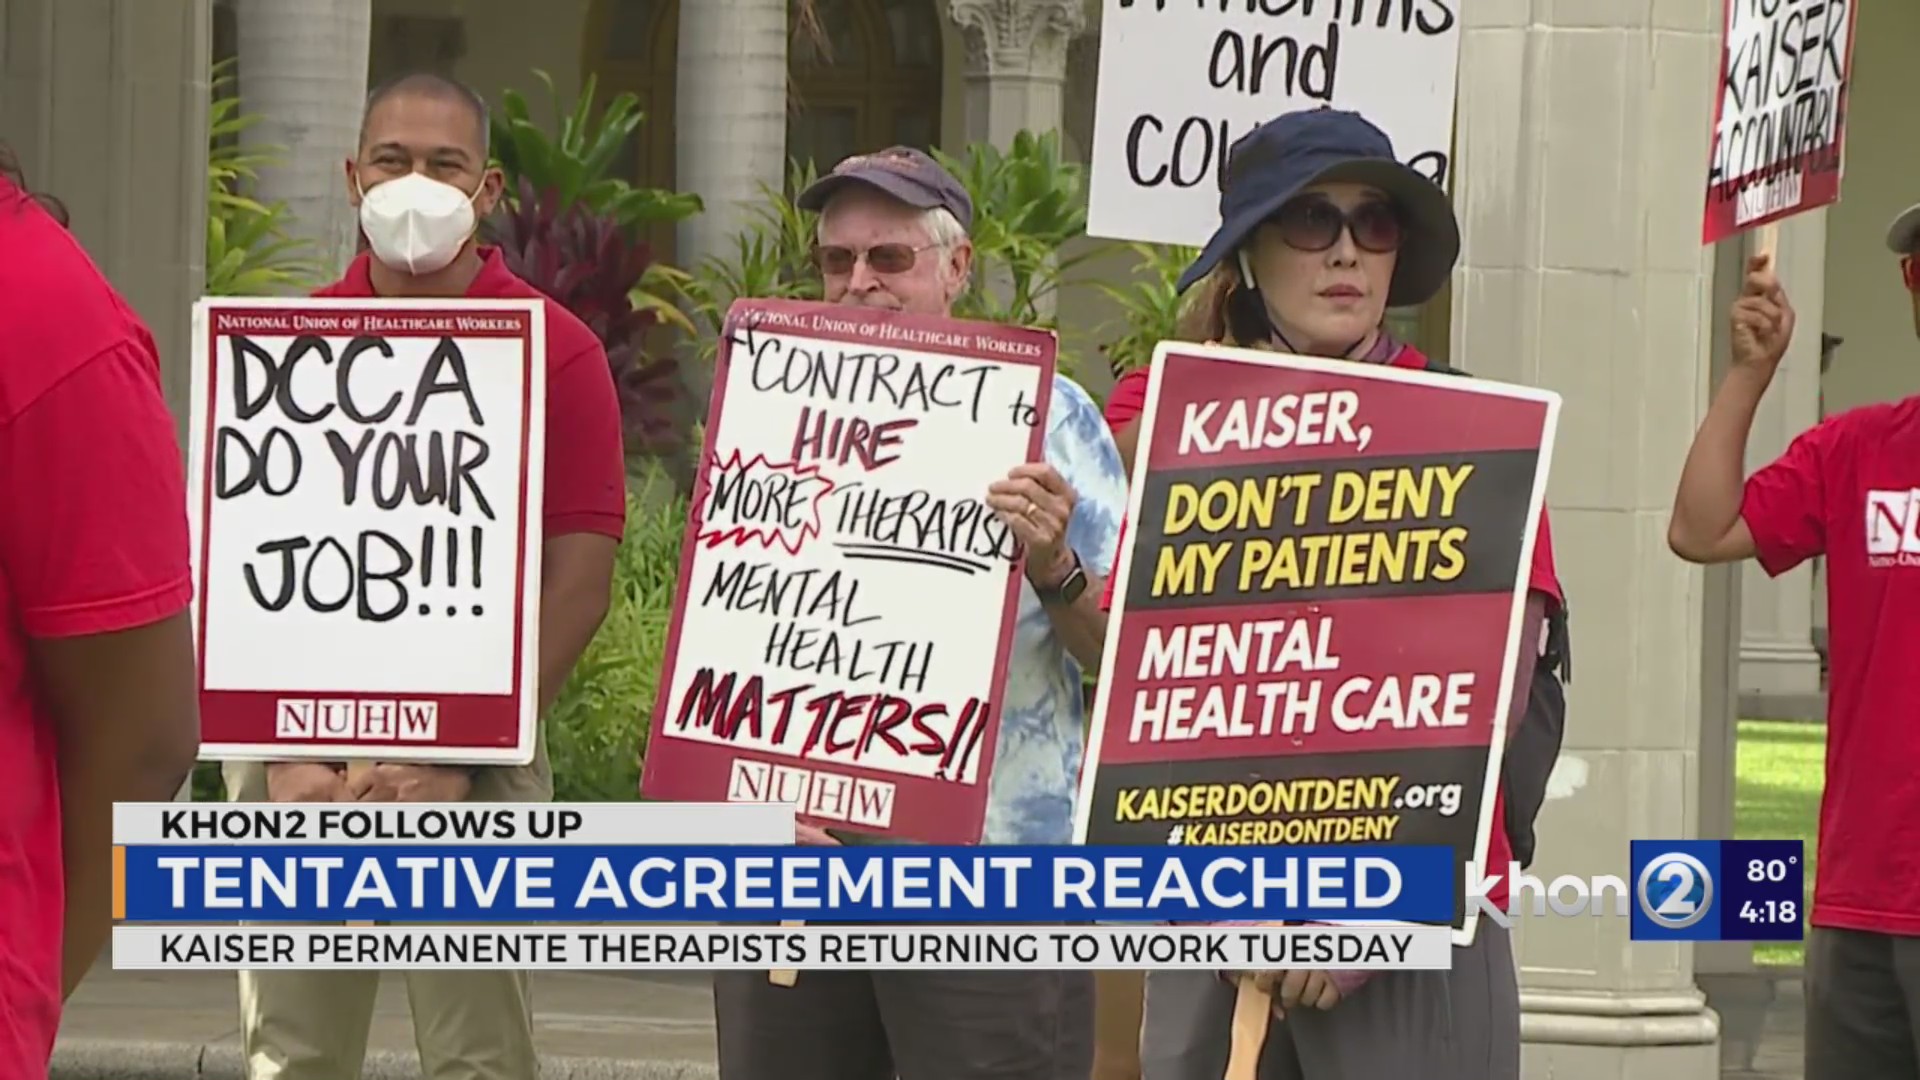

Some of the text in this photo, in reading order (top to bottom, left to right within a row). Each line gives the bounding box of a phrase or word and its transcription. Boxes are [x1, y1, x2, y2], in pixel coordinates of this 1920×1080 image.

[1209, 22, 1339, 101] and
[1727, 0, 1845, 112] KAISER
[217, 314, 290, 329] NATIONAL
[293, 315, 338, 330] UNION
[363, 315, 454, 331] HEALTHCARE
[456, 317, 521, 331] WORKERS
[812, 315, 857, 334] UNION
[879, 323, 971, 348] HEALTHCARE
[976, 335, 1041, 357] WORKERS
[230, 335, 485, 426] DCCA
[752, 338, 1001, 423] CONTRACT
[1008, 391, 1041, 427] to
[792, 406, 919, 472] HIRE
[1178, 390, 1373, 453] KAISER,
[216, 426, 496, 521] DO YOUR
[707, 467, 817, 528] MORE
[1162, 465, 1474, 535] DON'T DENY
[1871, 498, 1920, 542] N
[243, 525, 484, 622] JOB!!!
[701, 561, 882, 627] MENTAL
[1151, 527, 1467, 597] MY PATIENTS
[764, 622, 934, 693] HEALTH
[1137, 616, 1340, 680] MENTAL
[279, 703, 436, 735] NUHW
[676, 667, 990, 781] MATTERS!!
[1128, 672, 1475, 744] HEALTH CARE
[732, 765, 892, 820] NUHW
[1115, 776, 1462, 816] KAISERDONTDENY.org
[1167, 816, 1399, 846] #KAISERDONTDENY
